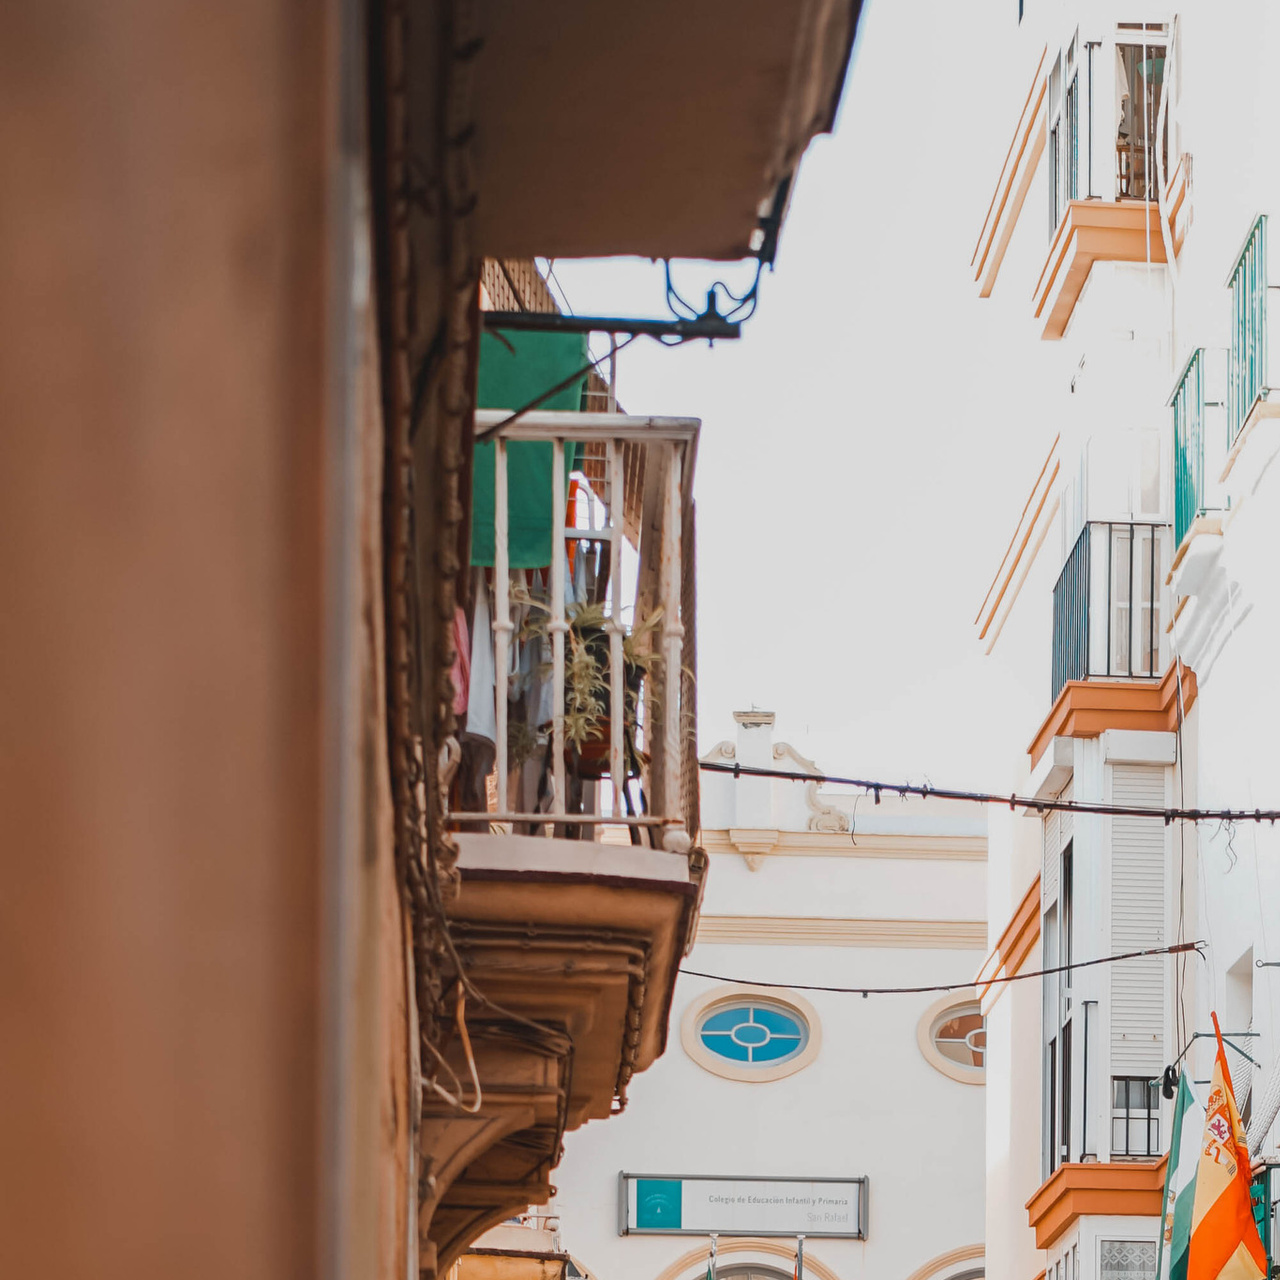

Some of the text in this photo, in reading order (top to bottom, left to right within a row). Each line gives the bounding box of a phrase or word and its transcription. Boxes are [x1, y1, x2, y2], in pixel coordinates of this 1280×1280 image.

[709, 1195, 735, 1204] Colegio
[737, 1195, 745, 1204] de
[785, 1196, 811, 1205] Infantil
[818, 1197, 848, 1205] Primaria
[807, 1212, 848, 1223] San Rafael
